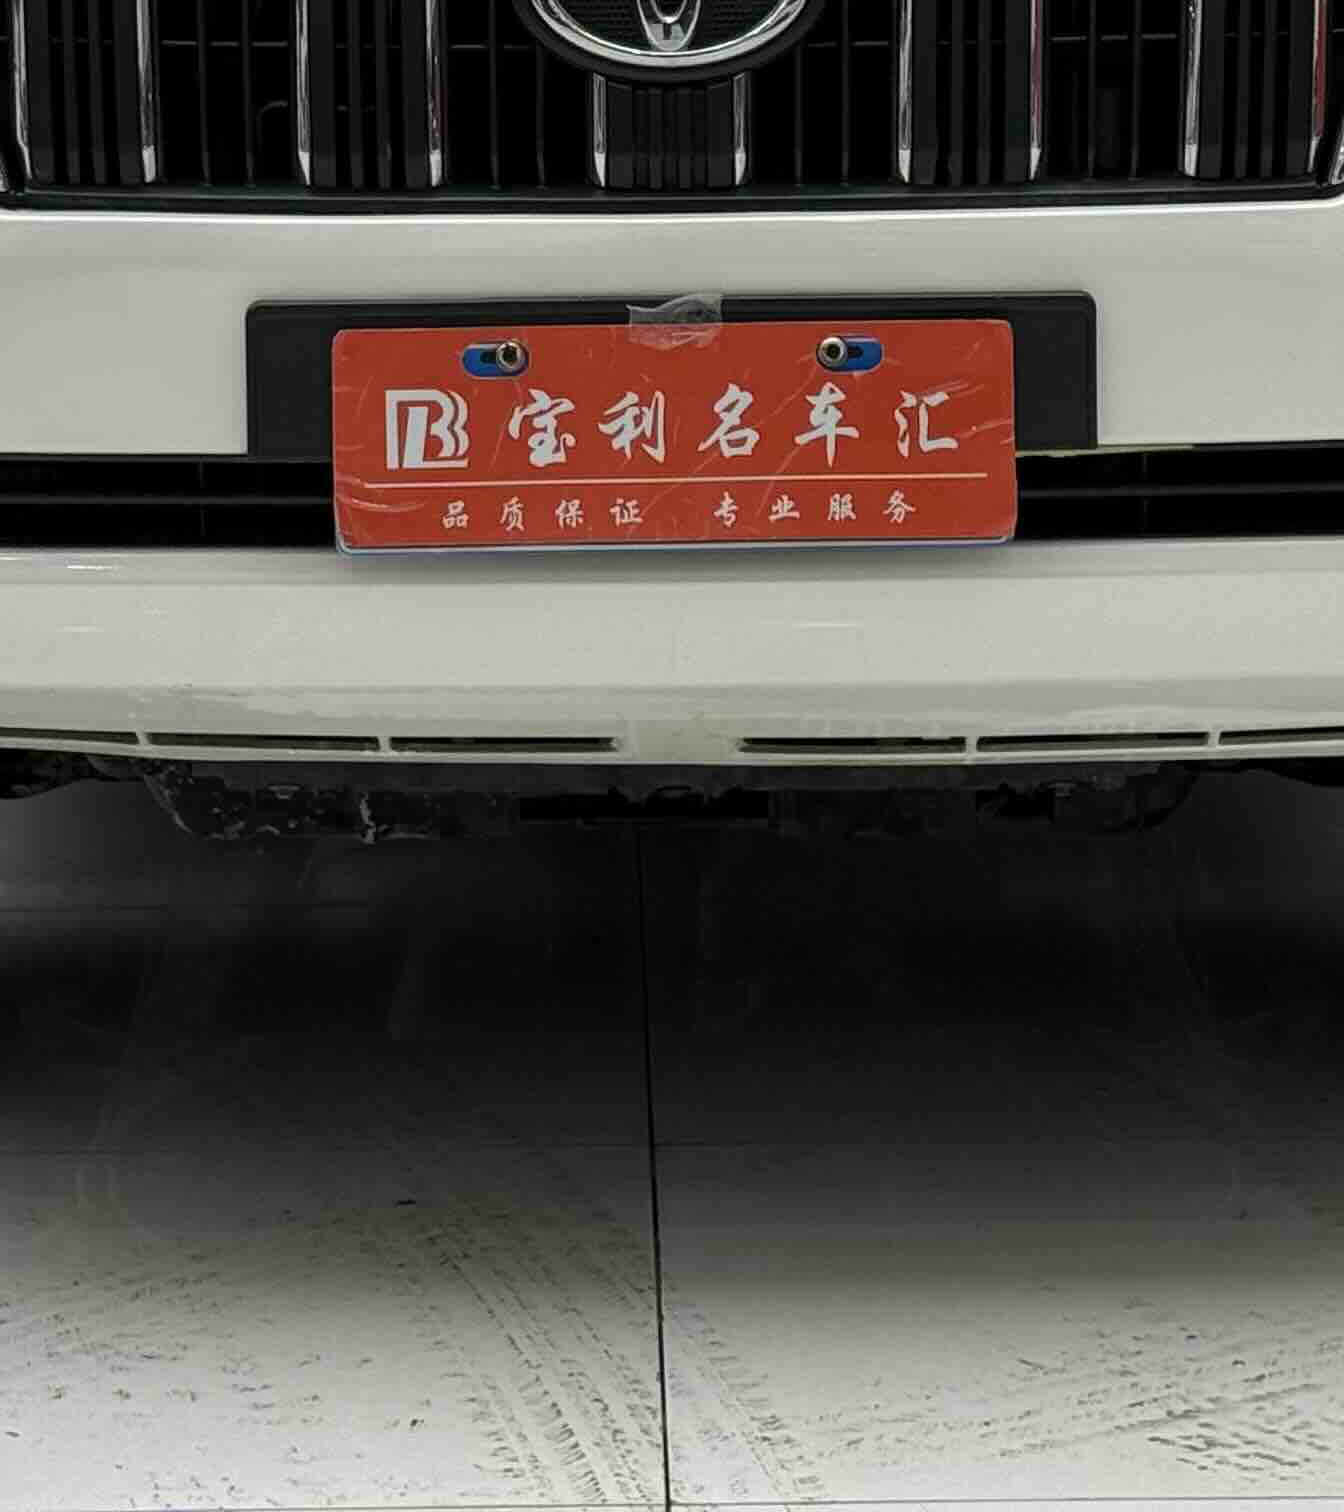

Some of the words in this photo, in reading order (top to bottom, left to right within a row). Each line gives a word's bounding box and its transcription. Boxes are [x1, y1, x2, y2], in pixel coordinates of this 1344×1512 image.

[508, 382, 958, 469] 宝利名车汇
[441, 496, 643, 531] 品质保证
[713, 490, 916, 527] 专业服务
